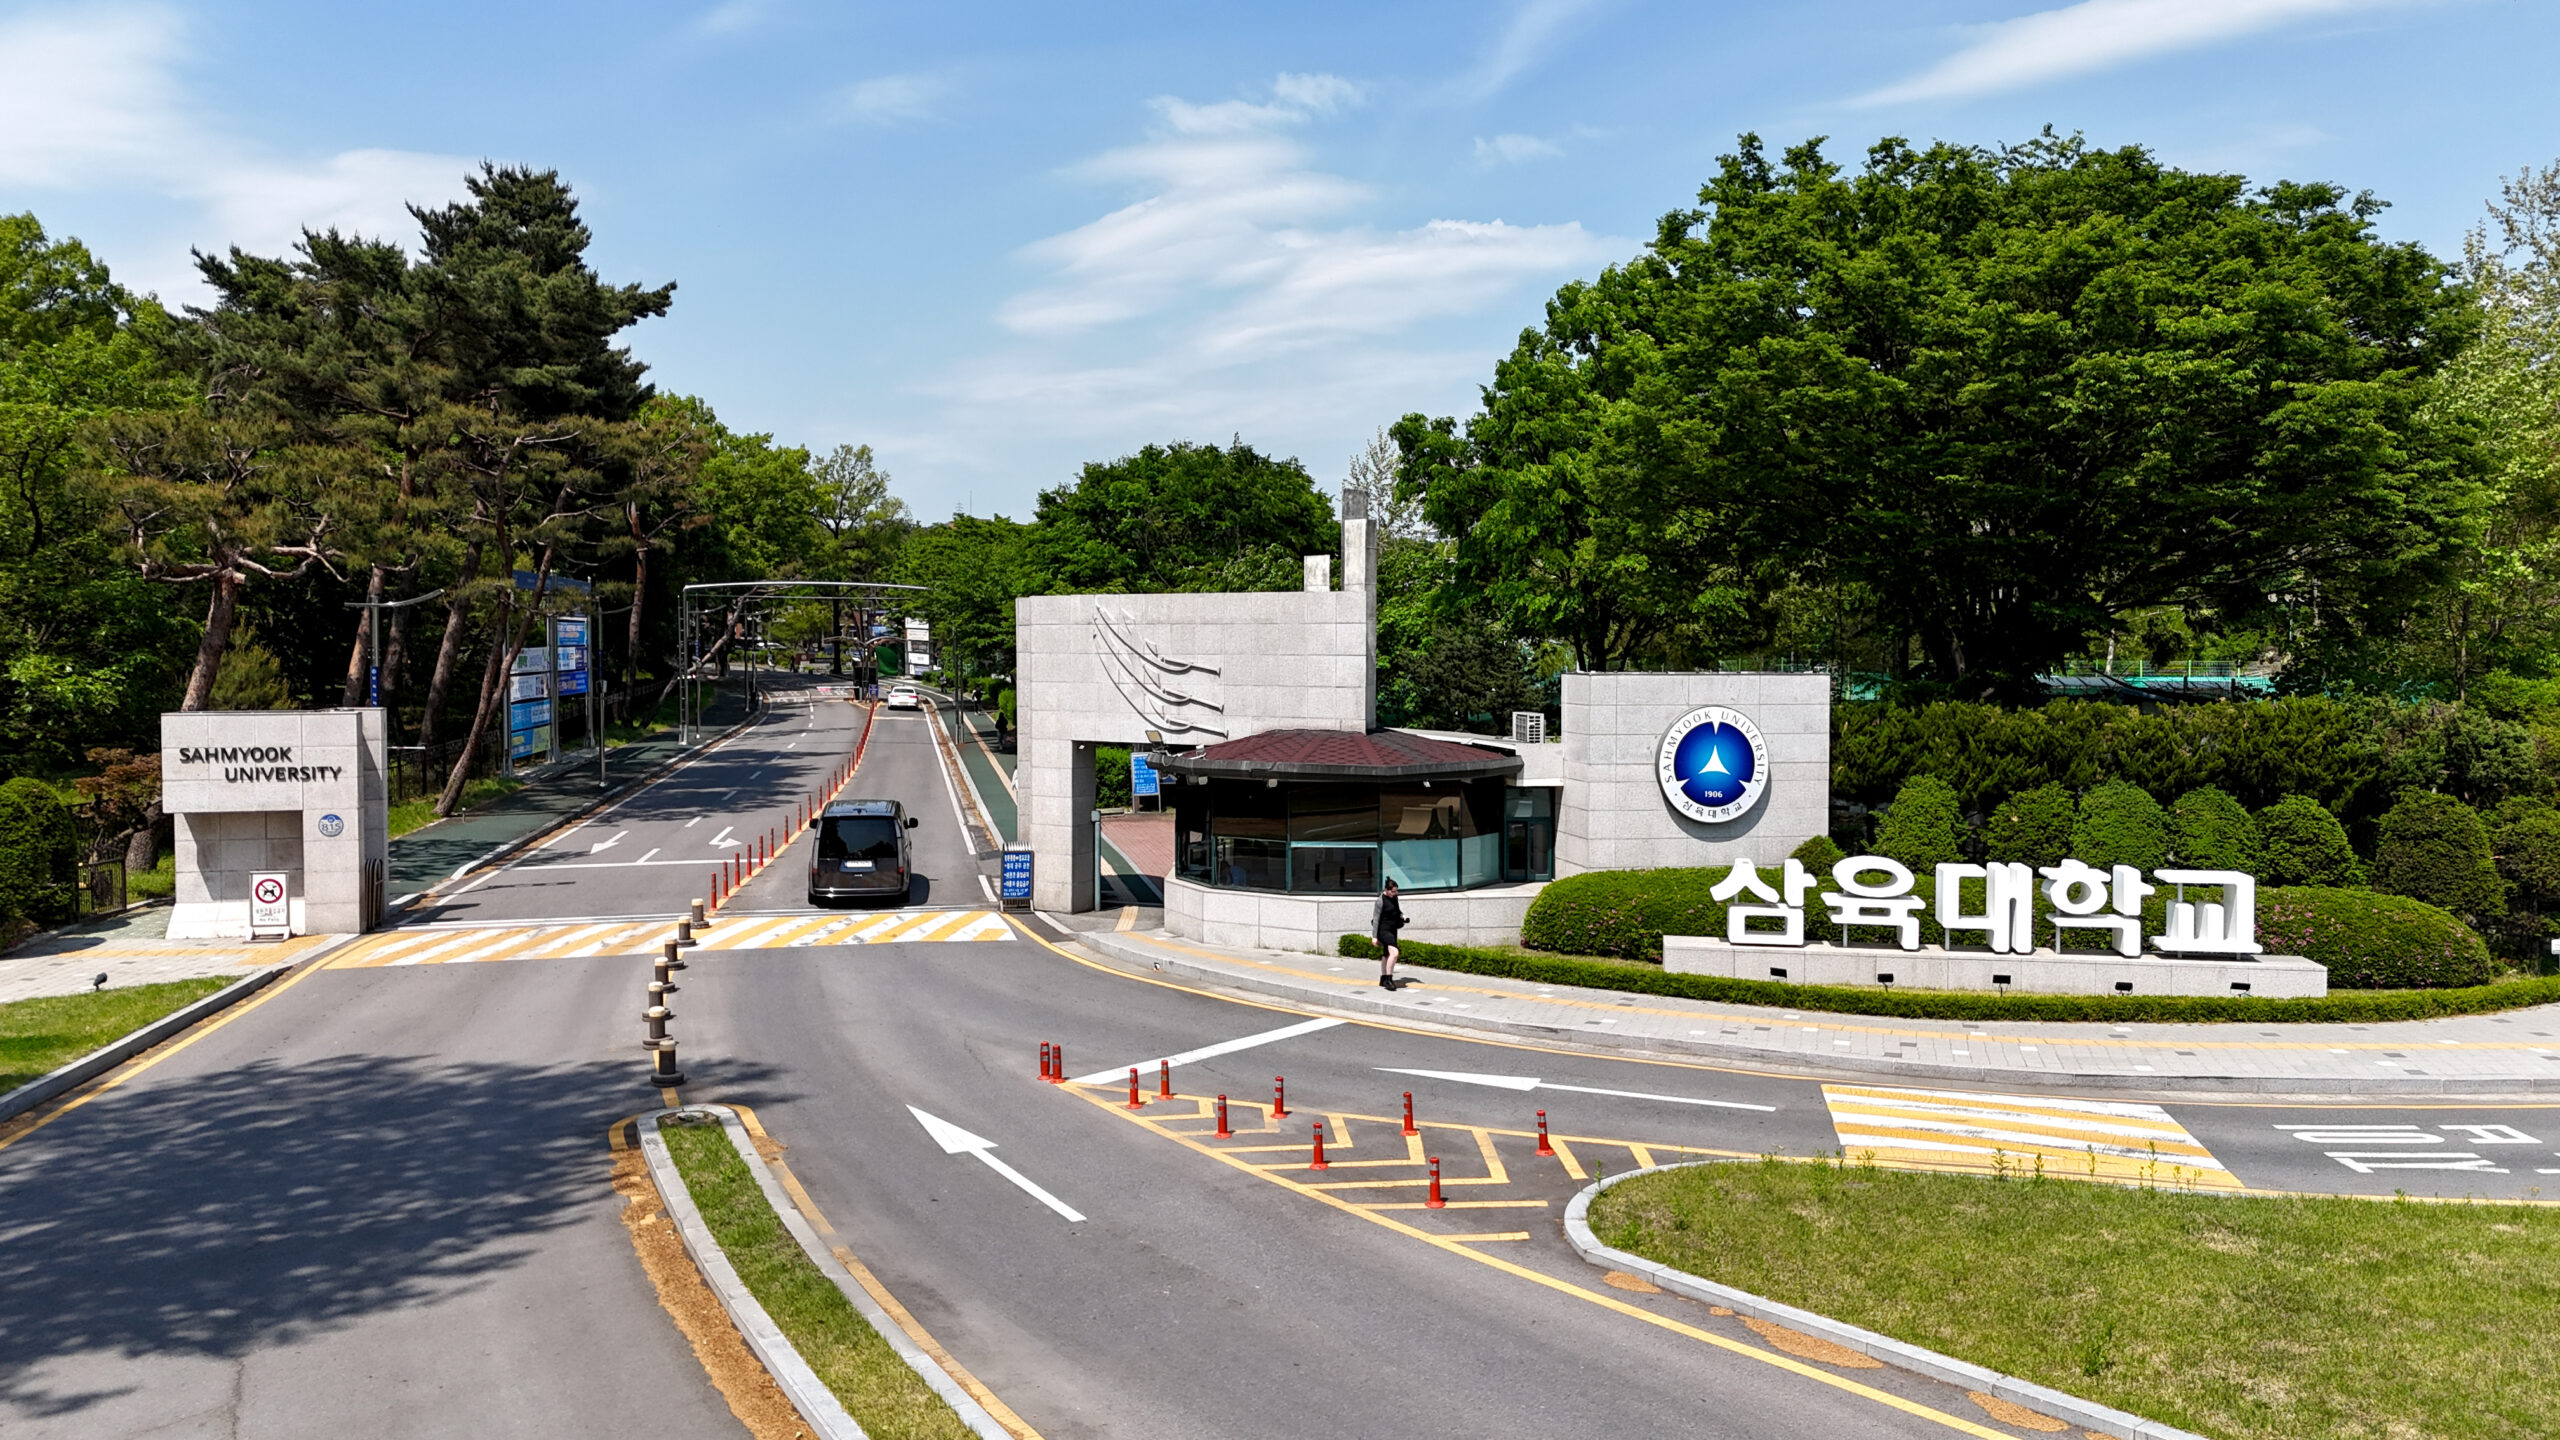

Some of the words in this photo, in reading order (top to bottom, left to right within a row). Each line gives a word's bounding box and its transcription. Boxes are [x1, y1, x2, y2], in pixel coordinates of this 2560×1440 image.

[179, 747, 293, 764] SAHMYOOK
[1663, 710, 1712, 783] SAHMYOOK
[1722, 711, 1766, 786] UNIVERSITY
[225, 766, 342, 783] UNIVERSITY
[1704, 790, 1723, 798] 1906
[1682, 800, 1743, 818] 삼육대학교
[1709, 856, 2264, 957] 삼육대학교
